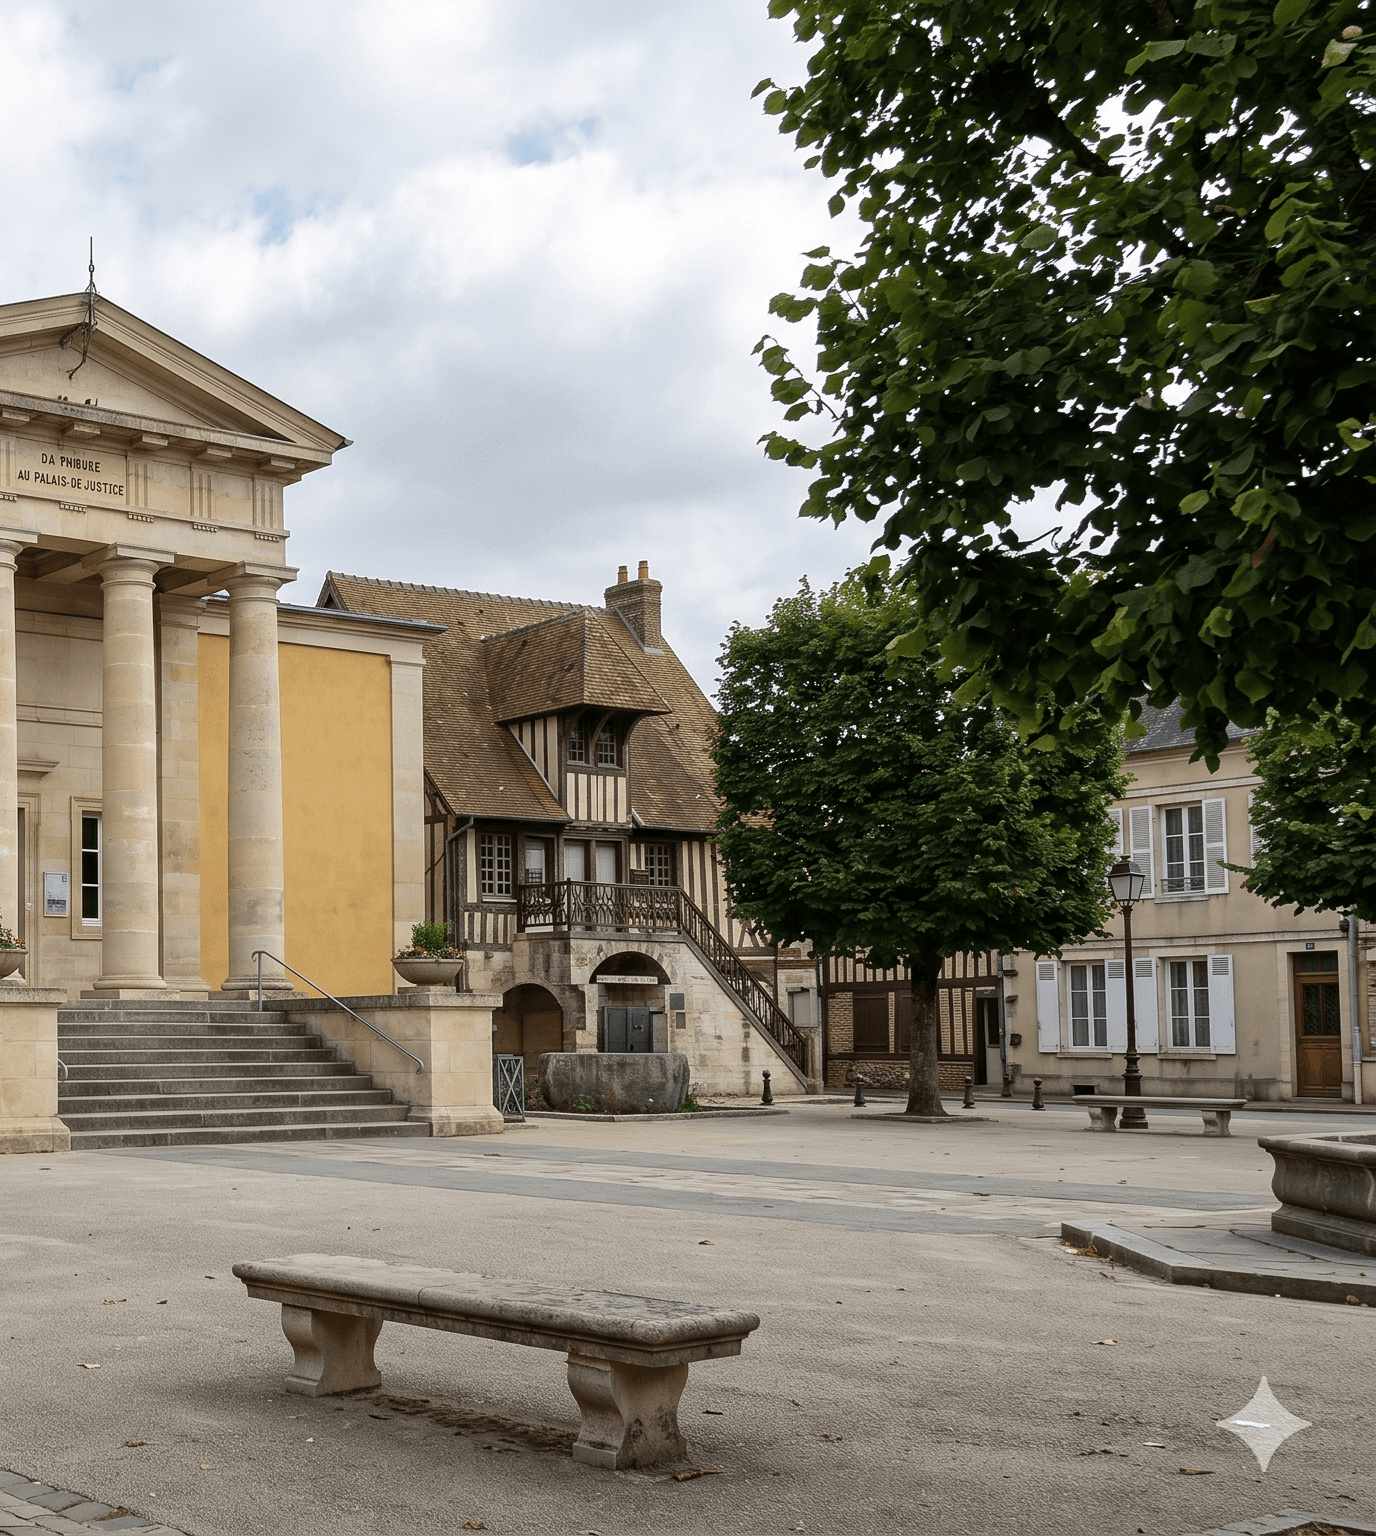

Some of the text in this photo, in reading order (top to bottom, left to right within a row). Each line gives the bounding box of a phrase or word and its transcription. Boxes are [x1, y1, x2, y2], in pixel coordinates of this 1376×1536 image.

[41, 453, 55, 465] DA
[18, 470, 30, 481] AU
[84, 480, 124, 496] JUSTICE
